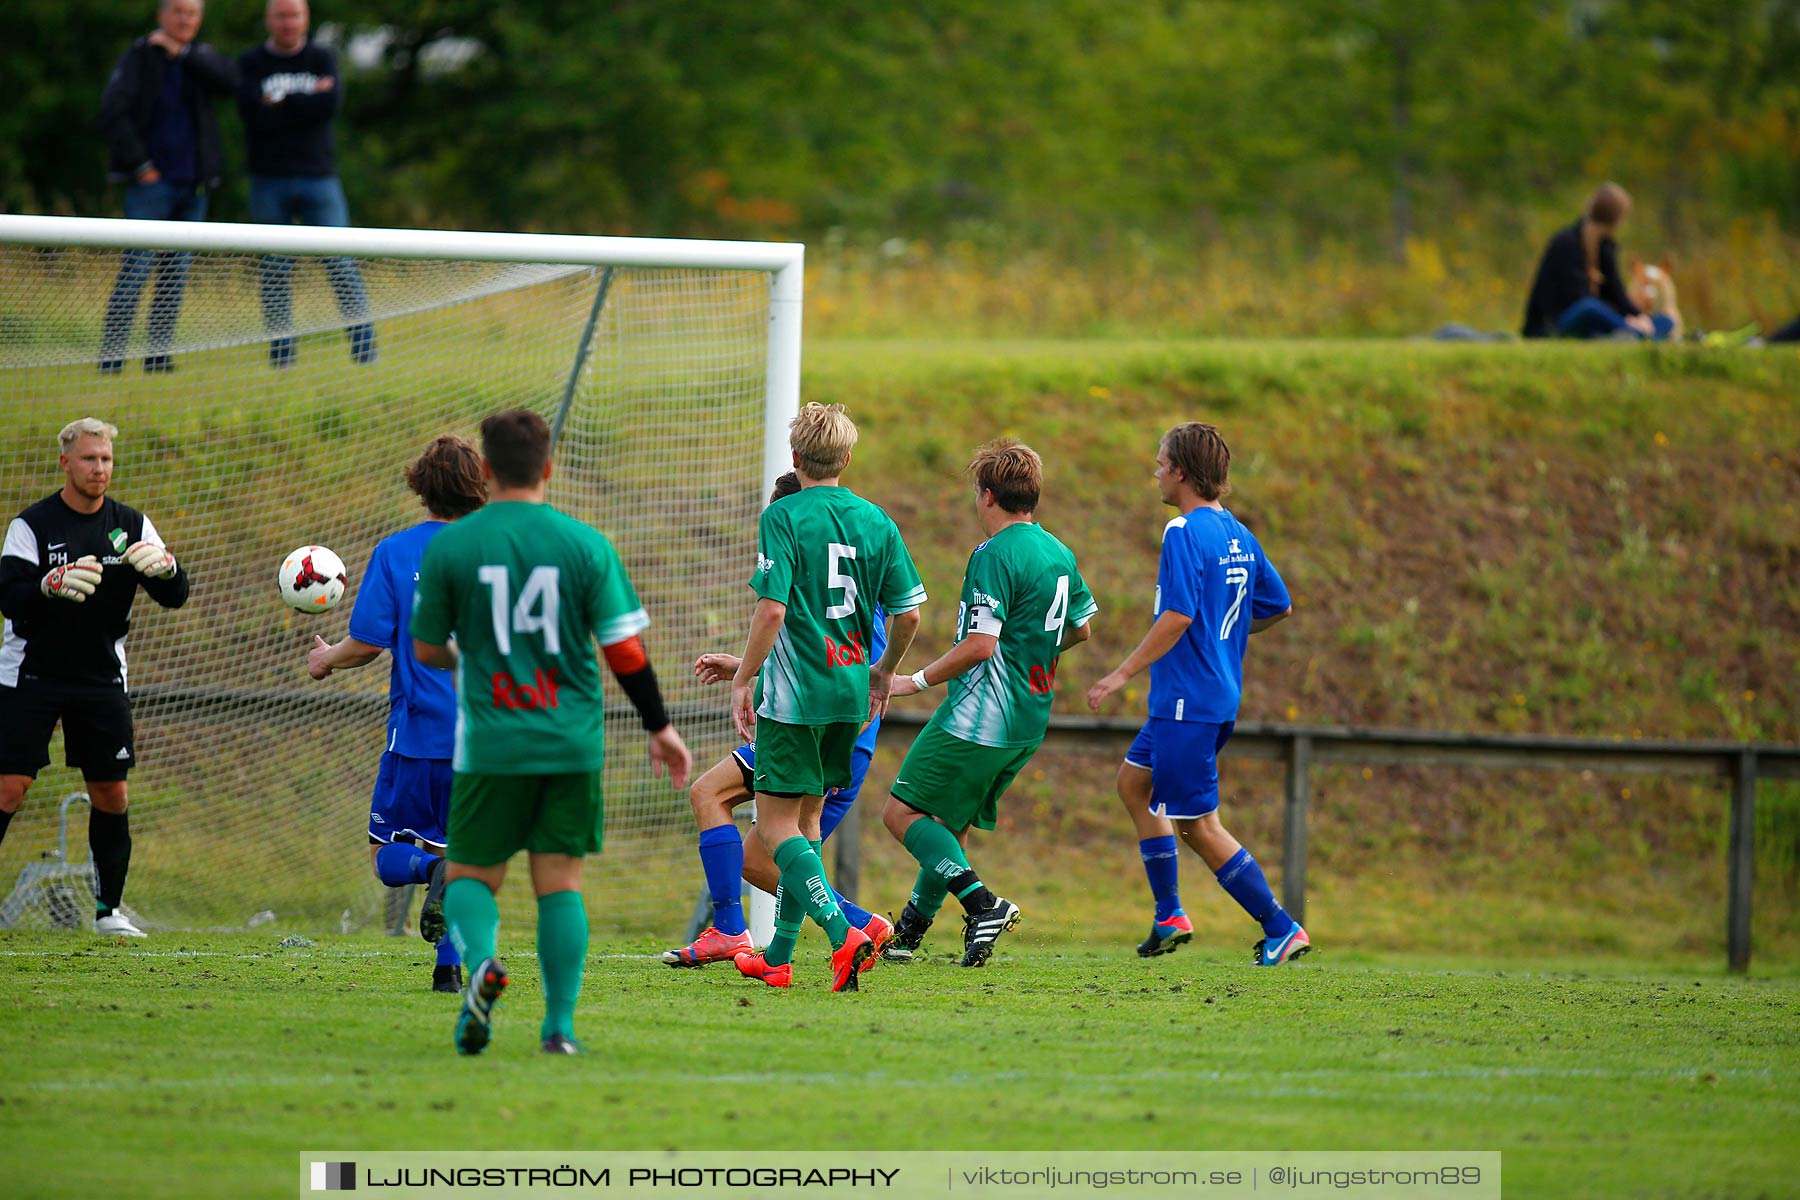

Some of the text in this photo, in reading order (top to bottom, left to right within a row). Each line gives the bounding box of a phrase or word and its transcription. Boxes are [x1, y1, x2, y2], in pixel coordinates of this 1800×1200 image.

[49, 552, 67, 565] PH
[826, 543, 858, 619] 5
[478, 565, 560, 655] 14
[1045, 575, 1069, 646] 4
[1220, 567, 1248, 640] 7
[492, 667, 560, 711] Rolf
